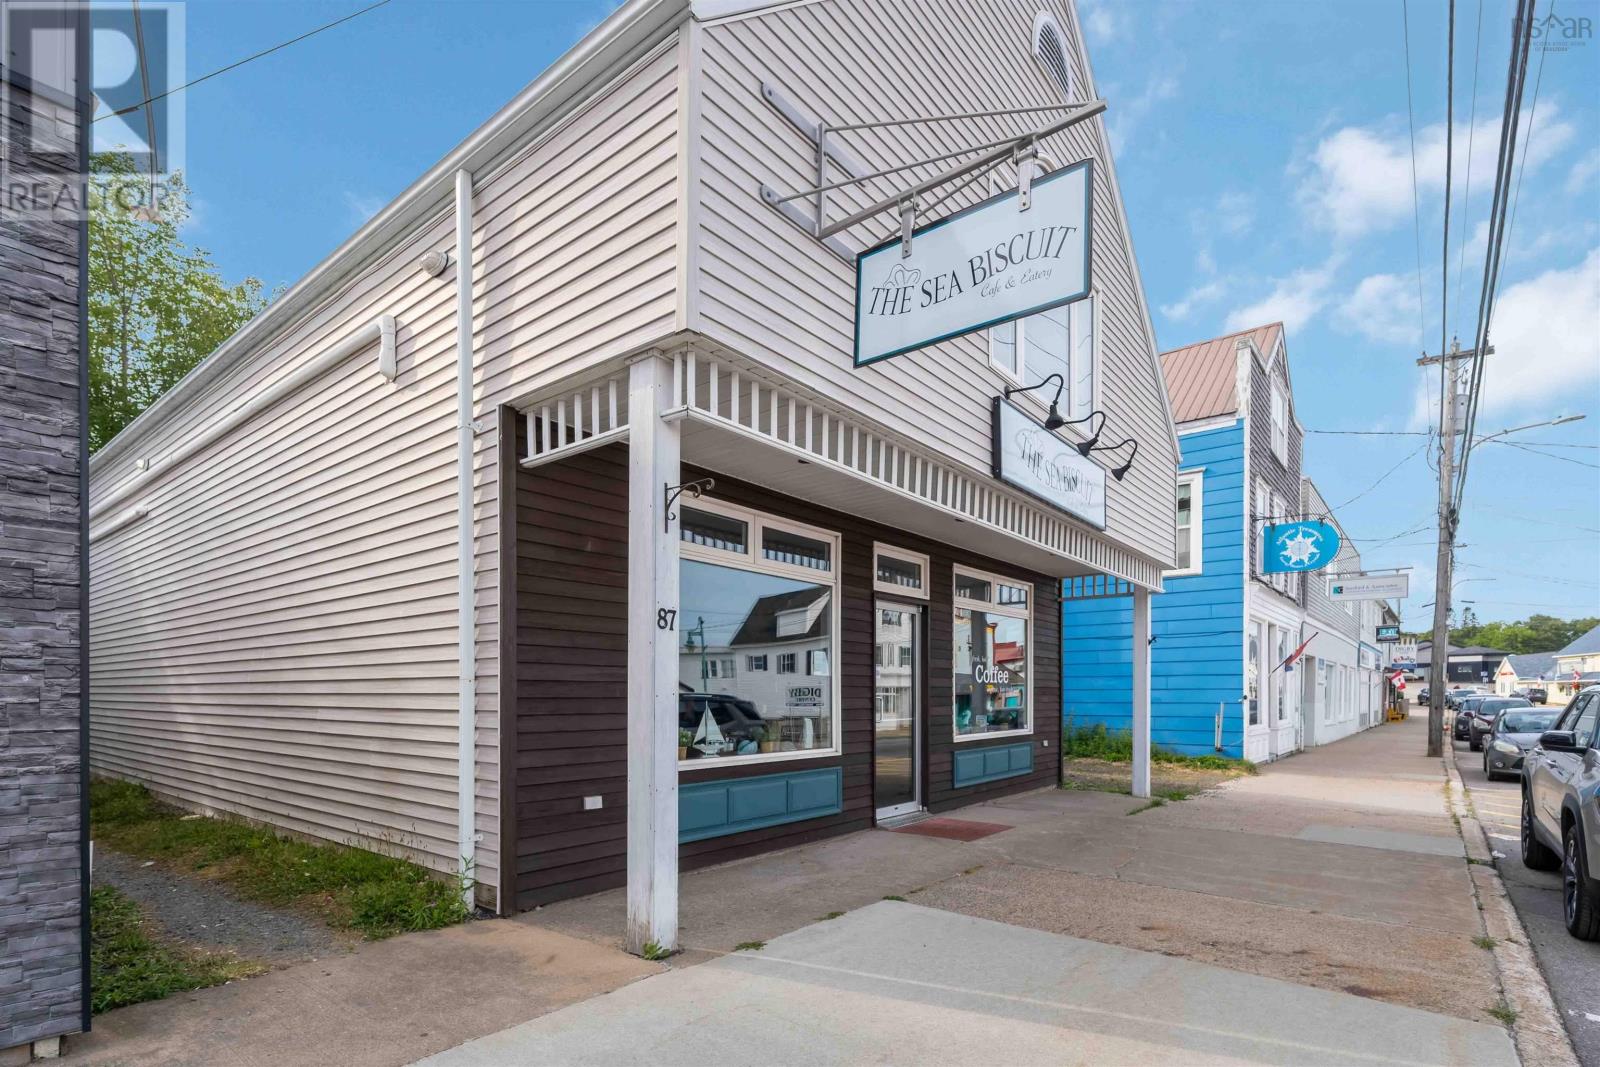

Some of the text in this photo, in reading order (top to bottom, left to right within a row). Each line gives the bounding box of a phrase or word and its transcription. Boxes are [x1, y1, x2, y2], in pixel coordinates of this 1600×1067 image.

[868, 226, 1077, 316] THE SEA BISCUIT
[980, 267, 1053, 299] Cafe & Eatery
[657, 608, 677, 631] 87
[975, 664, 1009, 684] Coffee
